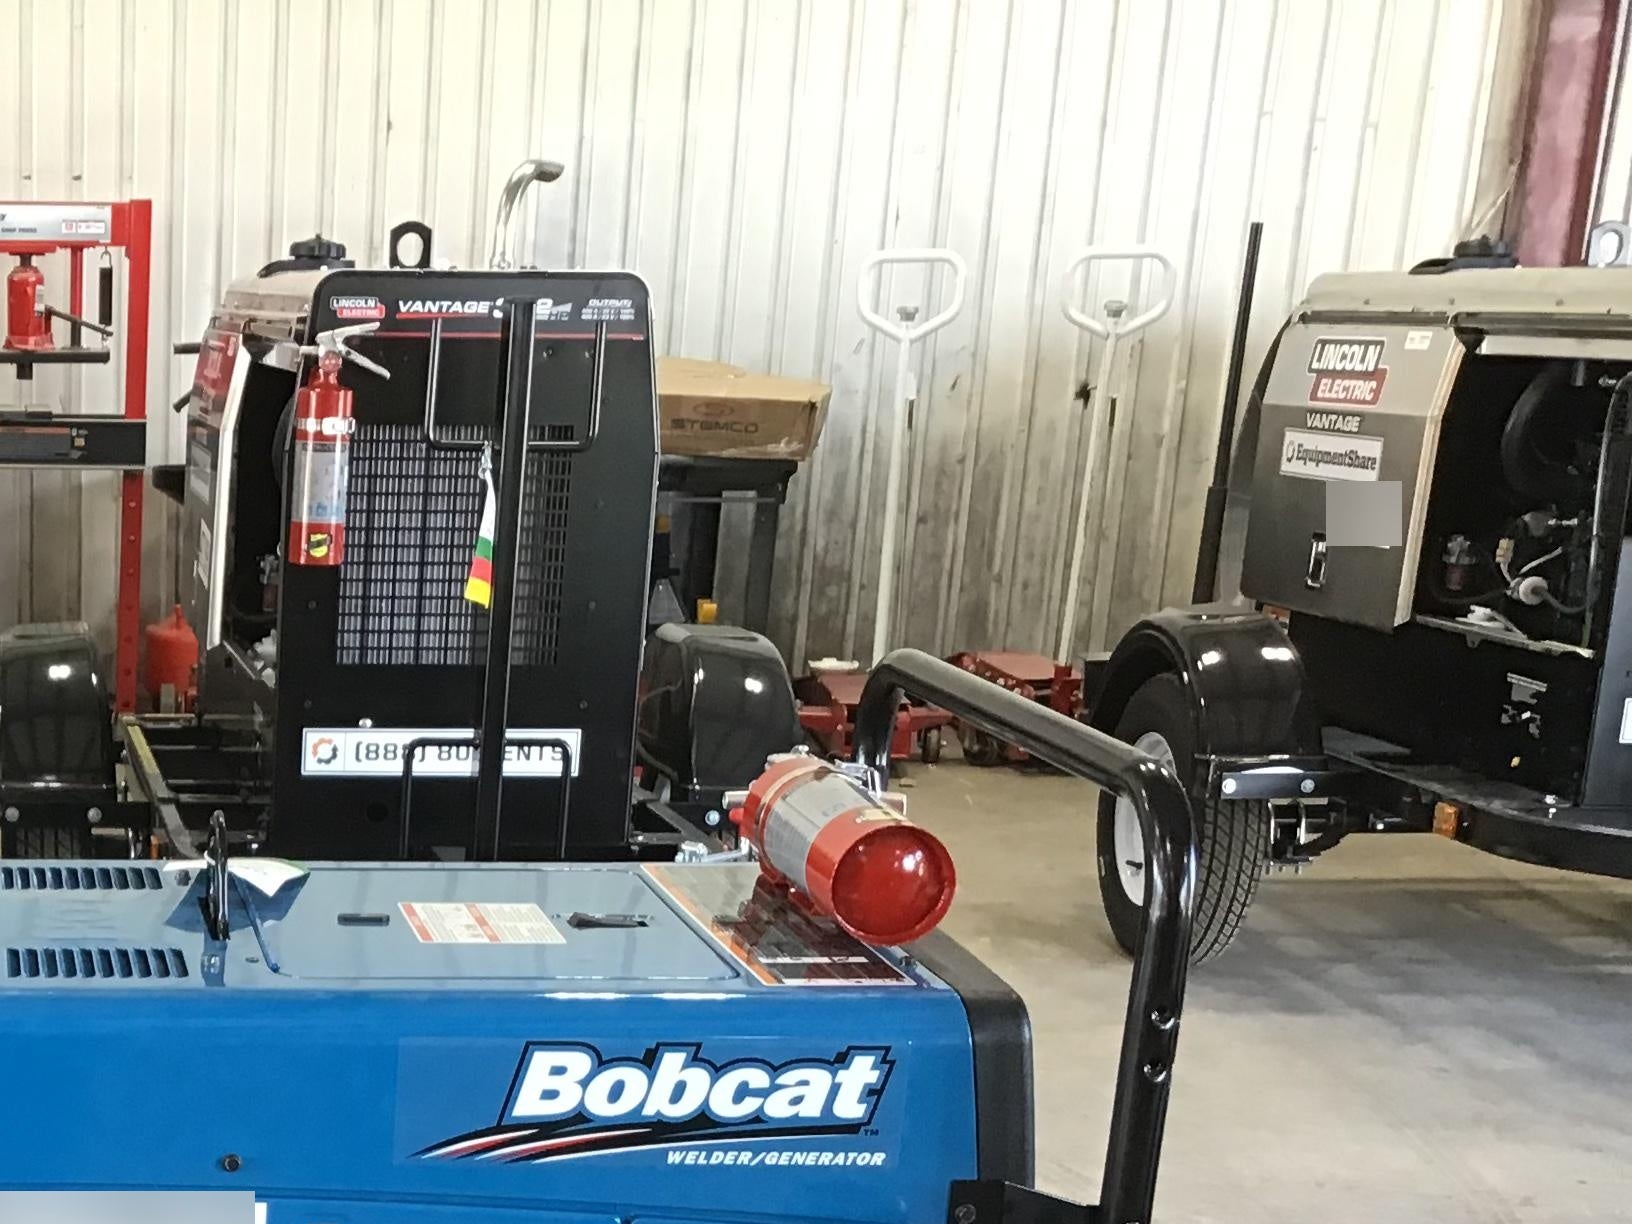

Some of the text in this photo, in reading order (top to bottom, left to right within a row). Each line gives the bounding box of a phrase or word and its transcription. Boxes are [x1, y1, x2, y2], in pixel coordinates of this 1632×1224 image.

[333, 299, 376, 308] LINCOLN
[398, 300, 489, 314] VANTAGE
[1311, 343, 1381, 372] LINCOLN
[1317, 378, 1377, 401] ELECTRIC
[671, 418, 759, 434] STEMCO
[1306, 412, 1362, 433] VANTAGE
[1295, 443, 1377, 471] EquipmentShare
[510, 1048, 882, 1120] Bobcat
[666, 1150, 887, 1168] WELDER/GENERATOR
